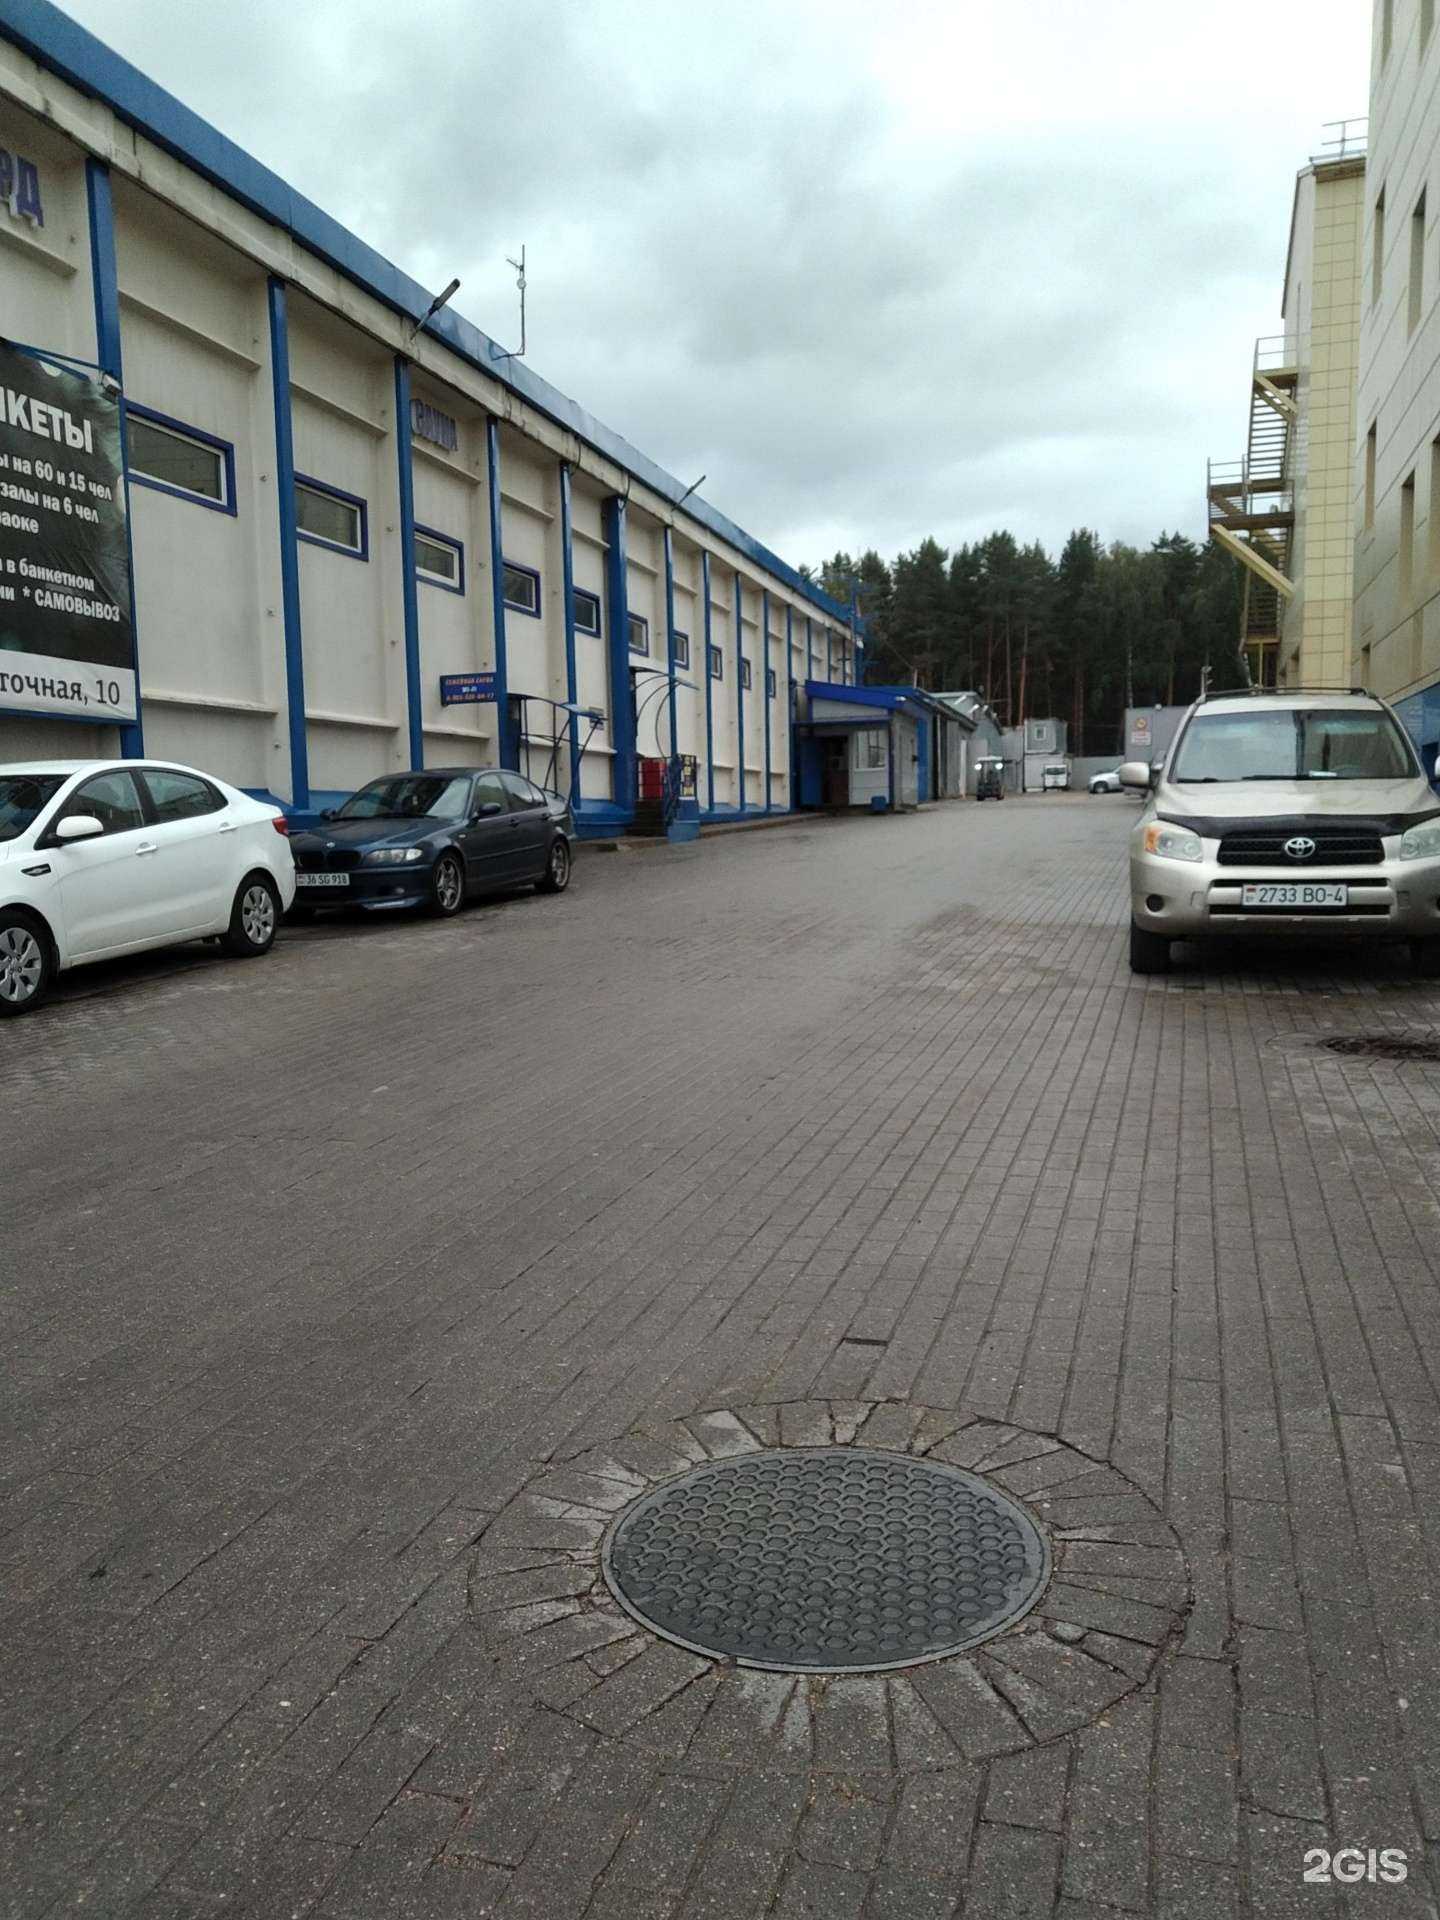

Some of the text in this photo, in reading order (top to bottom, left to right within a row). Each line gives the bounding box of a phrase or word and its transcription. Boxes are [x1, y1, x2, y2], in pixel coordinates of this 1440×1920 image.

[13, 456, 32, 475] на
[35, 460, 53, 481] 60
[57, 470, 65, 486] и
[69, 471, 86, 492] 15
[89, 480, 112, 500] чел
[0, 481, 99, 524] залы на 6 чел
[0, 511, 39, 533] аоке
[6, 558, 95, 592] в банкетном
[35, 588, 120, 622] САМОВЫВОЗ
[96, 680, 120, 705] 10
[1259, 887, 1297, 903] 2733
[1303, 887, 1343, 903] BO-4
